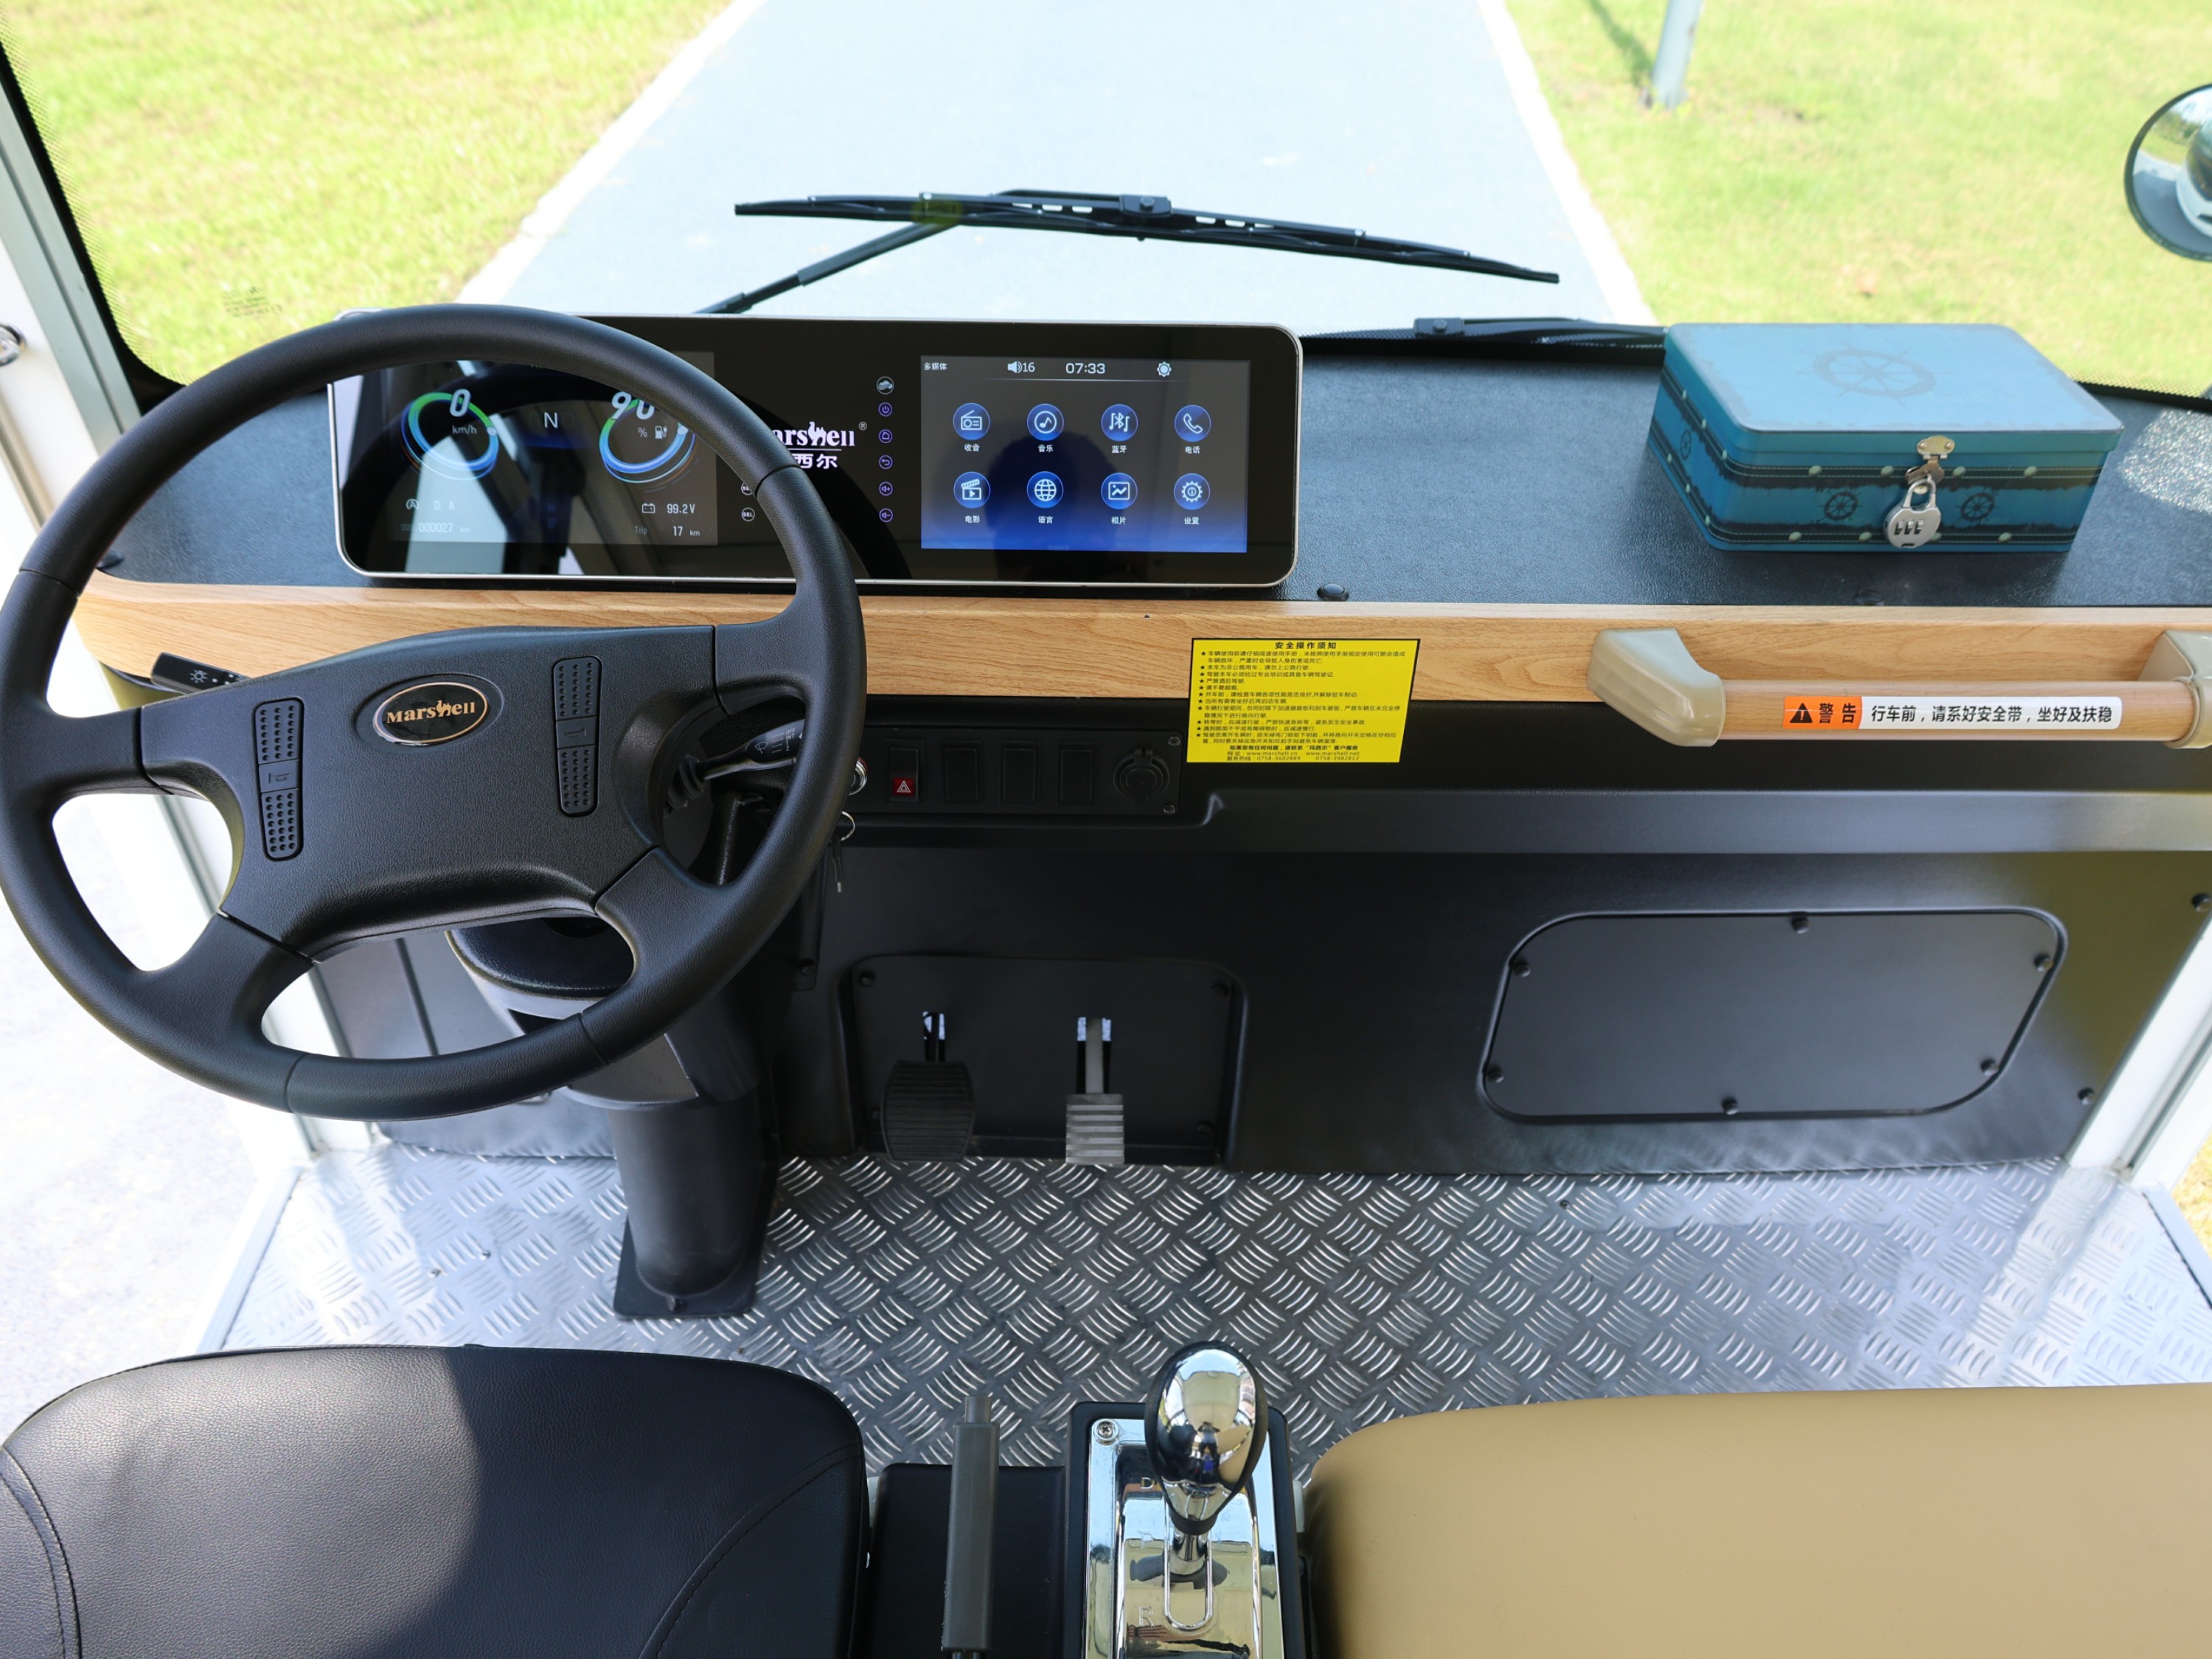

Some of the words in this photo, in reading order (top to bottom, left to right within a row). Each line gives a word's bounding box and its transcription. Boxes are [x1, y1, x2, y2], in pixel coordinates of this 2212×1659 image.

[924, 362, 947, 371] 多媒体
[1023, 362, 1035, 372] 16
[1065, 363, 1106, 374] 07:33
[449, 389, 471, 417] 0
[543, 412, 558, 428] N
[452, 425, 477, 434] km/h
[964, 444, 980, 452] 收音
[1037, 445, 1054, 453] 音乐
[1111, 445, 1127, 453] 蓝牙
[1185, 446, 1200, 454] 电话
[793, 453, 838, 469] 西尔
[965, 515, 980, 524] 电影
[1038, 516, 1053, 524] 语言
[1111, 517, 1126, 525] 相片
[673, 526, 683, 536] 17
[1871, 706, 2112, 723] 行车前，请系好安全带，坐好及扶稳
[1141, 1477, 1155, 1489] D
